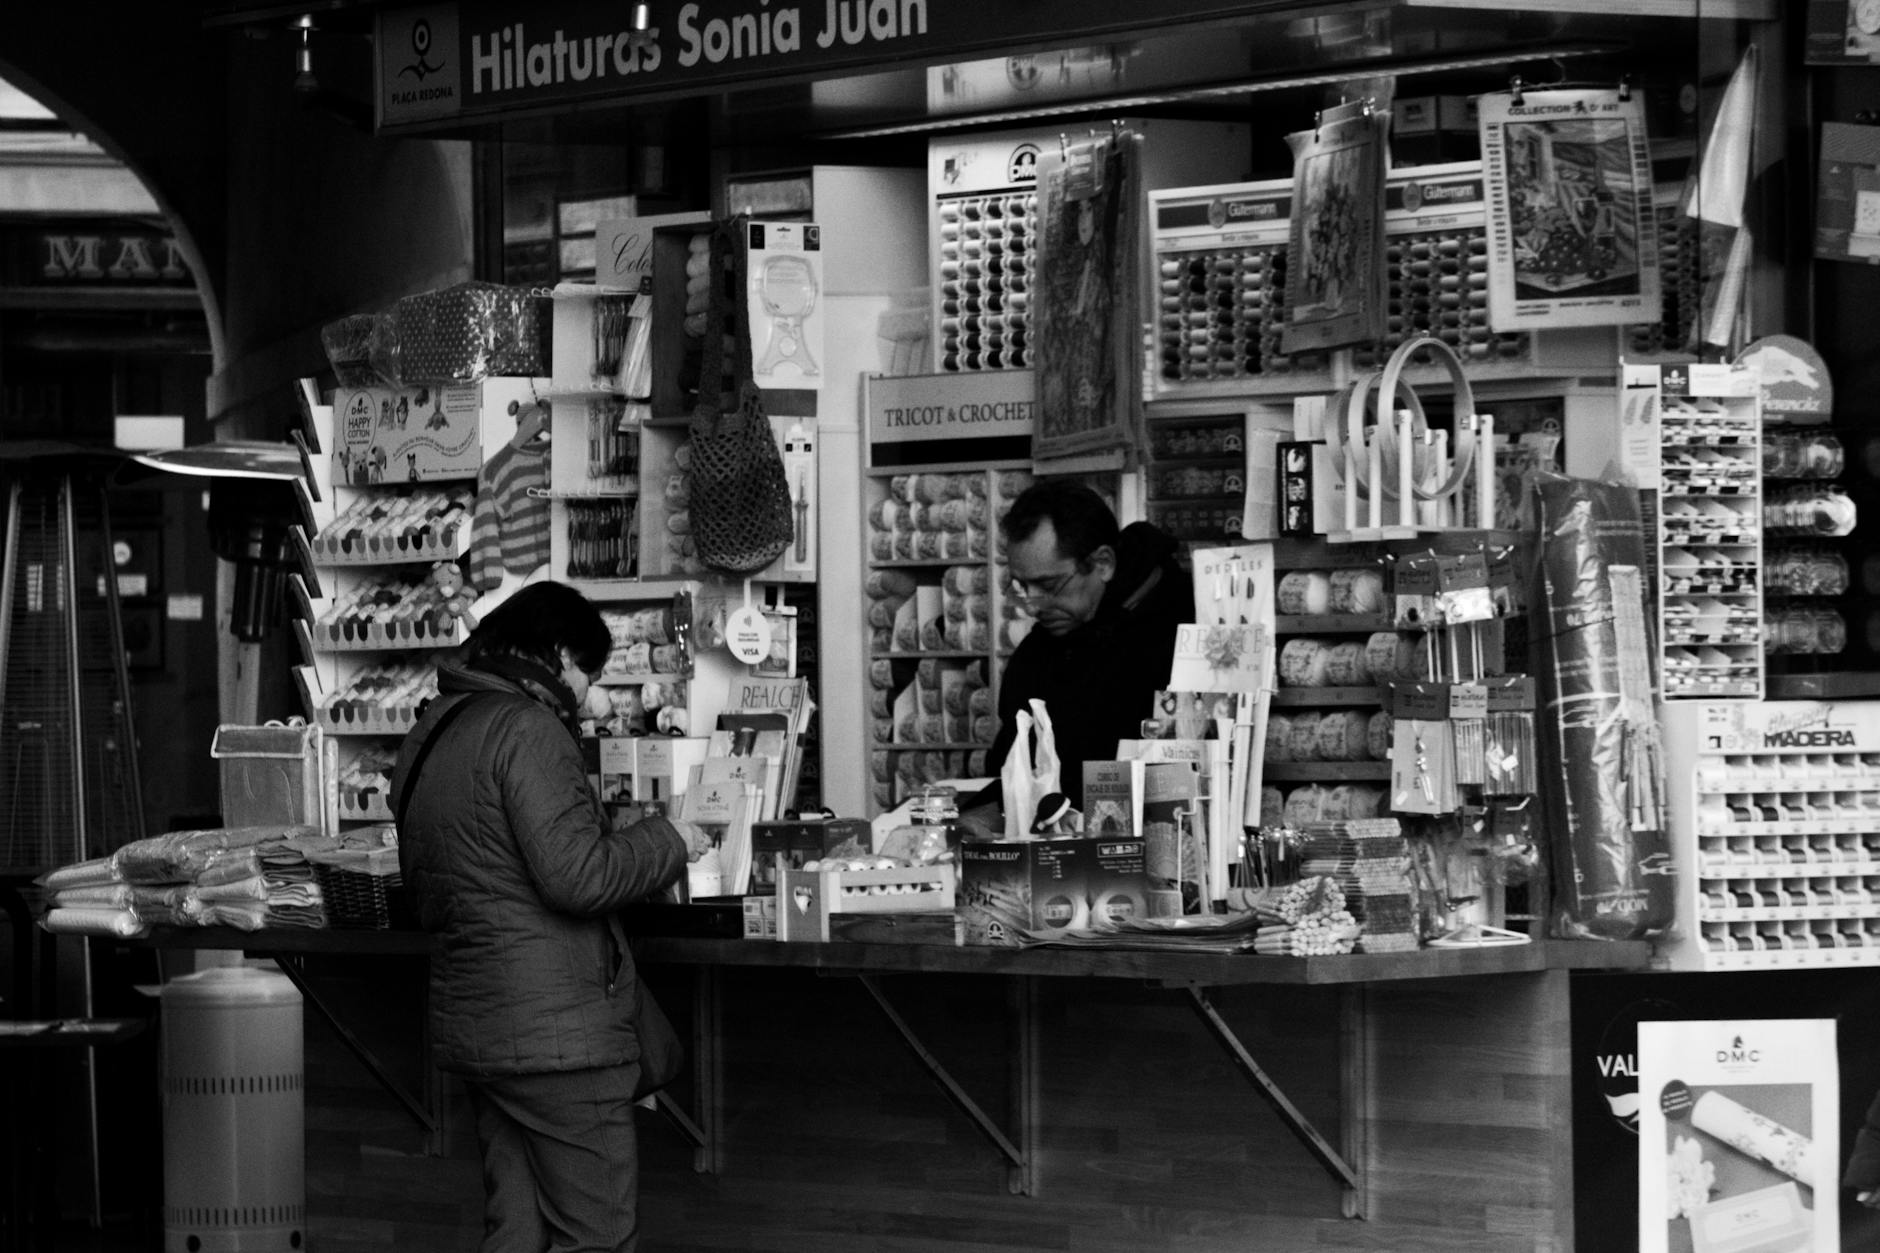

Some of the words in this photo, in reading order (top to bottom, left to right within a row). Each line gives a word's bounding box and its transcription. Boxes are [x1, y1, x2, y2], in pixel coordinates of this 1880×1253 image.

[472, 23, 662, 94] Hilaturas
[678, 0, 800, 67] Sonia
[816, 0, 928, 48] Juan
[419, 86, 454, 102] REDONA
[1508, 104, 1571, 116] COLLECTION
[1602, 103, 1620, 112] ART
[1424, 184, 1475, 200] Gütermann
[1228, 202, 1277, 217] Gütermann
[352, 406, 369, 415] DMC
[884, 406, 944, 428] TRICOT
[947, 408, 956, 422] &
[959, 401, 1035, 424] CROCHET
[348, 417, 371, 430] HAPPY
[347, 430, 371, 438] COTTON
[743, 648, 760, 656] VISA
[741, 685, 800, 709] REALCE
[1764, 731, 1856, 747] MADEIRA
[1716, 1050, 1761, 1063] DMC
